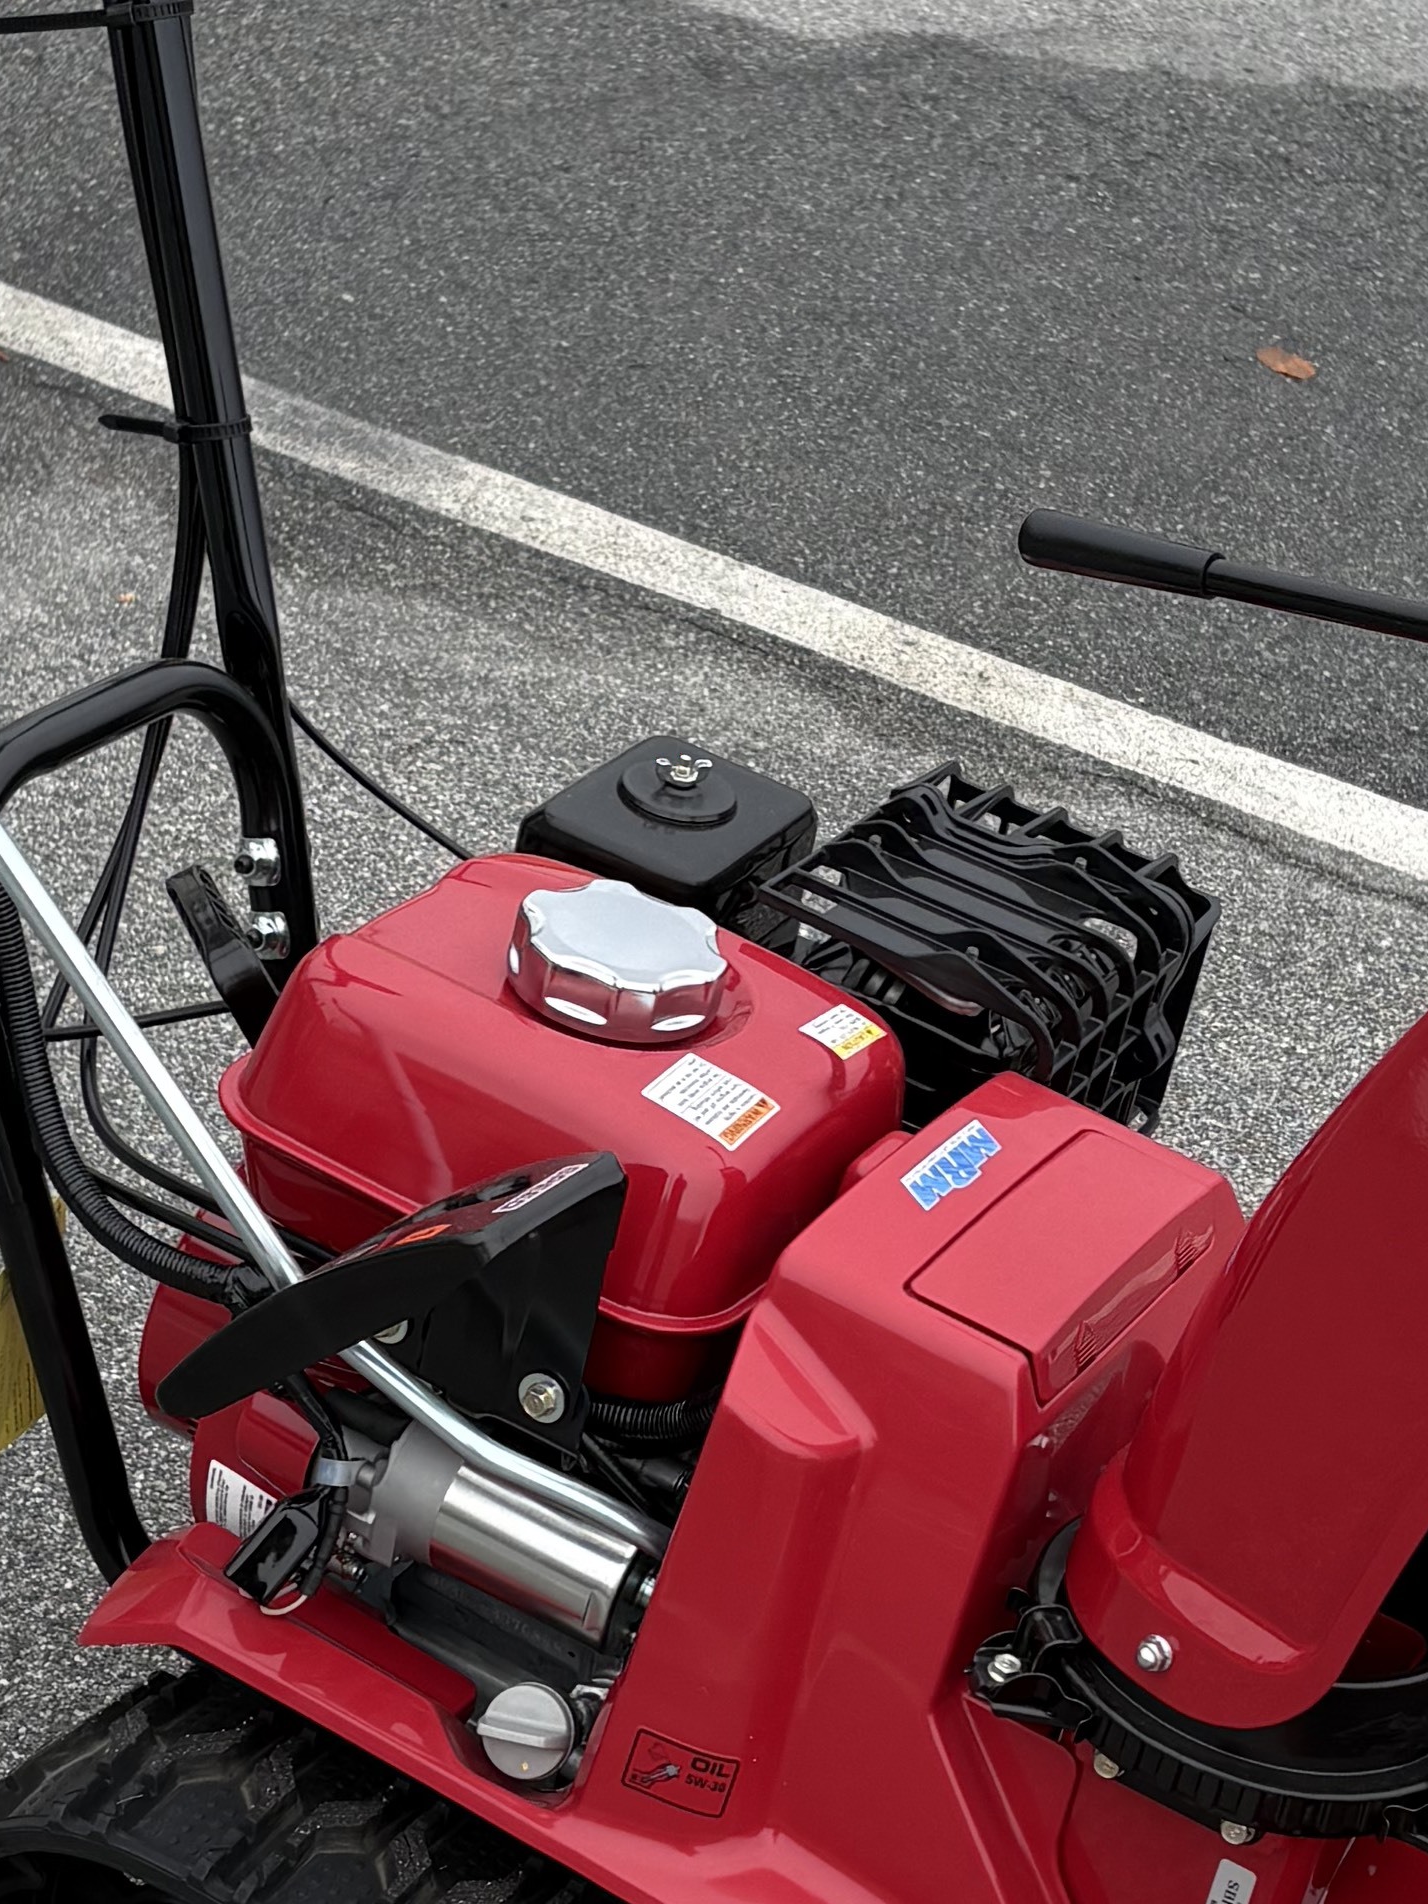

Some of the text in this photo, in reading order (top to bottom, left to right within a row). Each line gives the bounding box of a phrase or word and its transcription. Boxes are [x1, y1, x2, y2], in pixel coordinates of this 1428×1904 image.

[723, 1107, 765, 1142] WARNING
[691, 1757, 731, 1778] OIL
[685, 1774, 727, 1793] 5W-30
